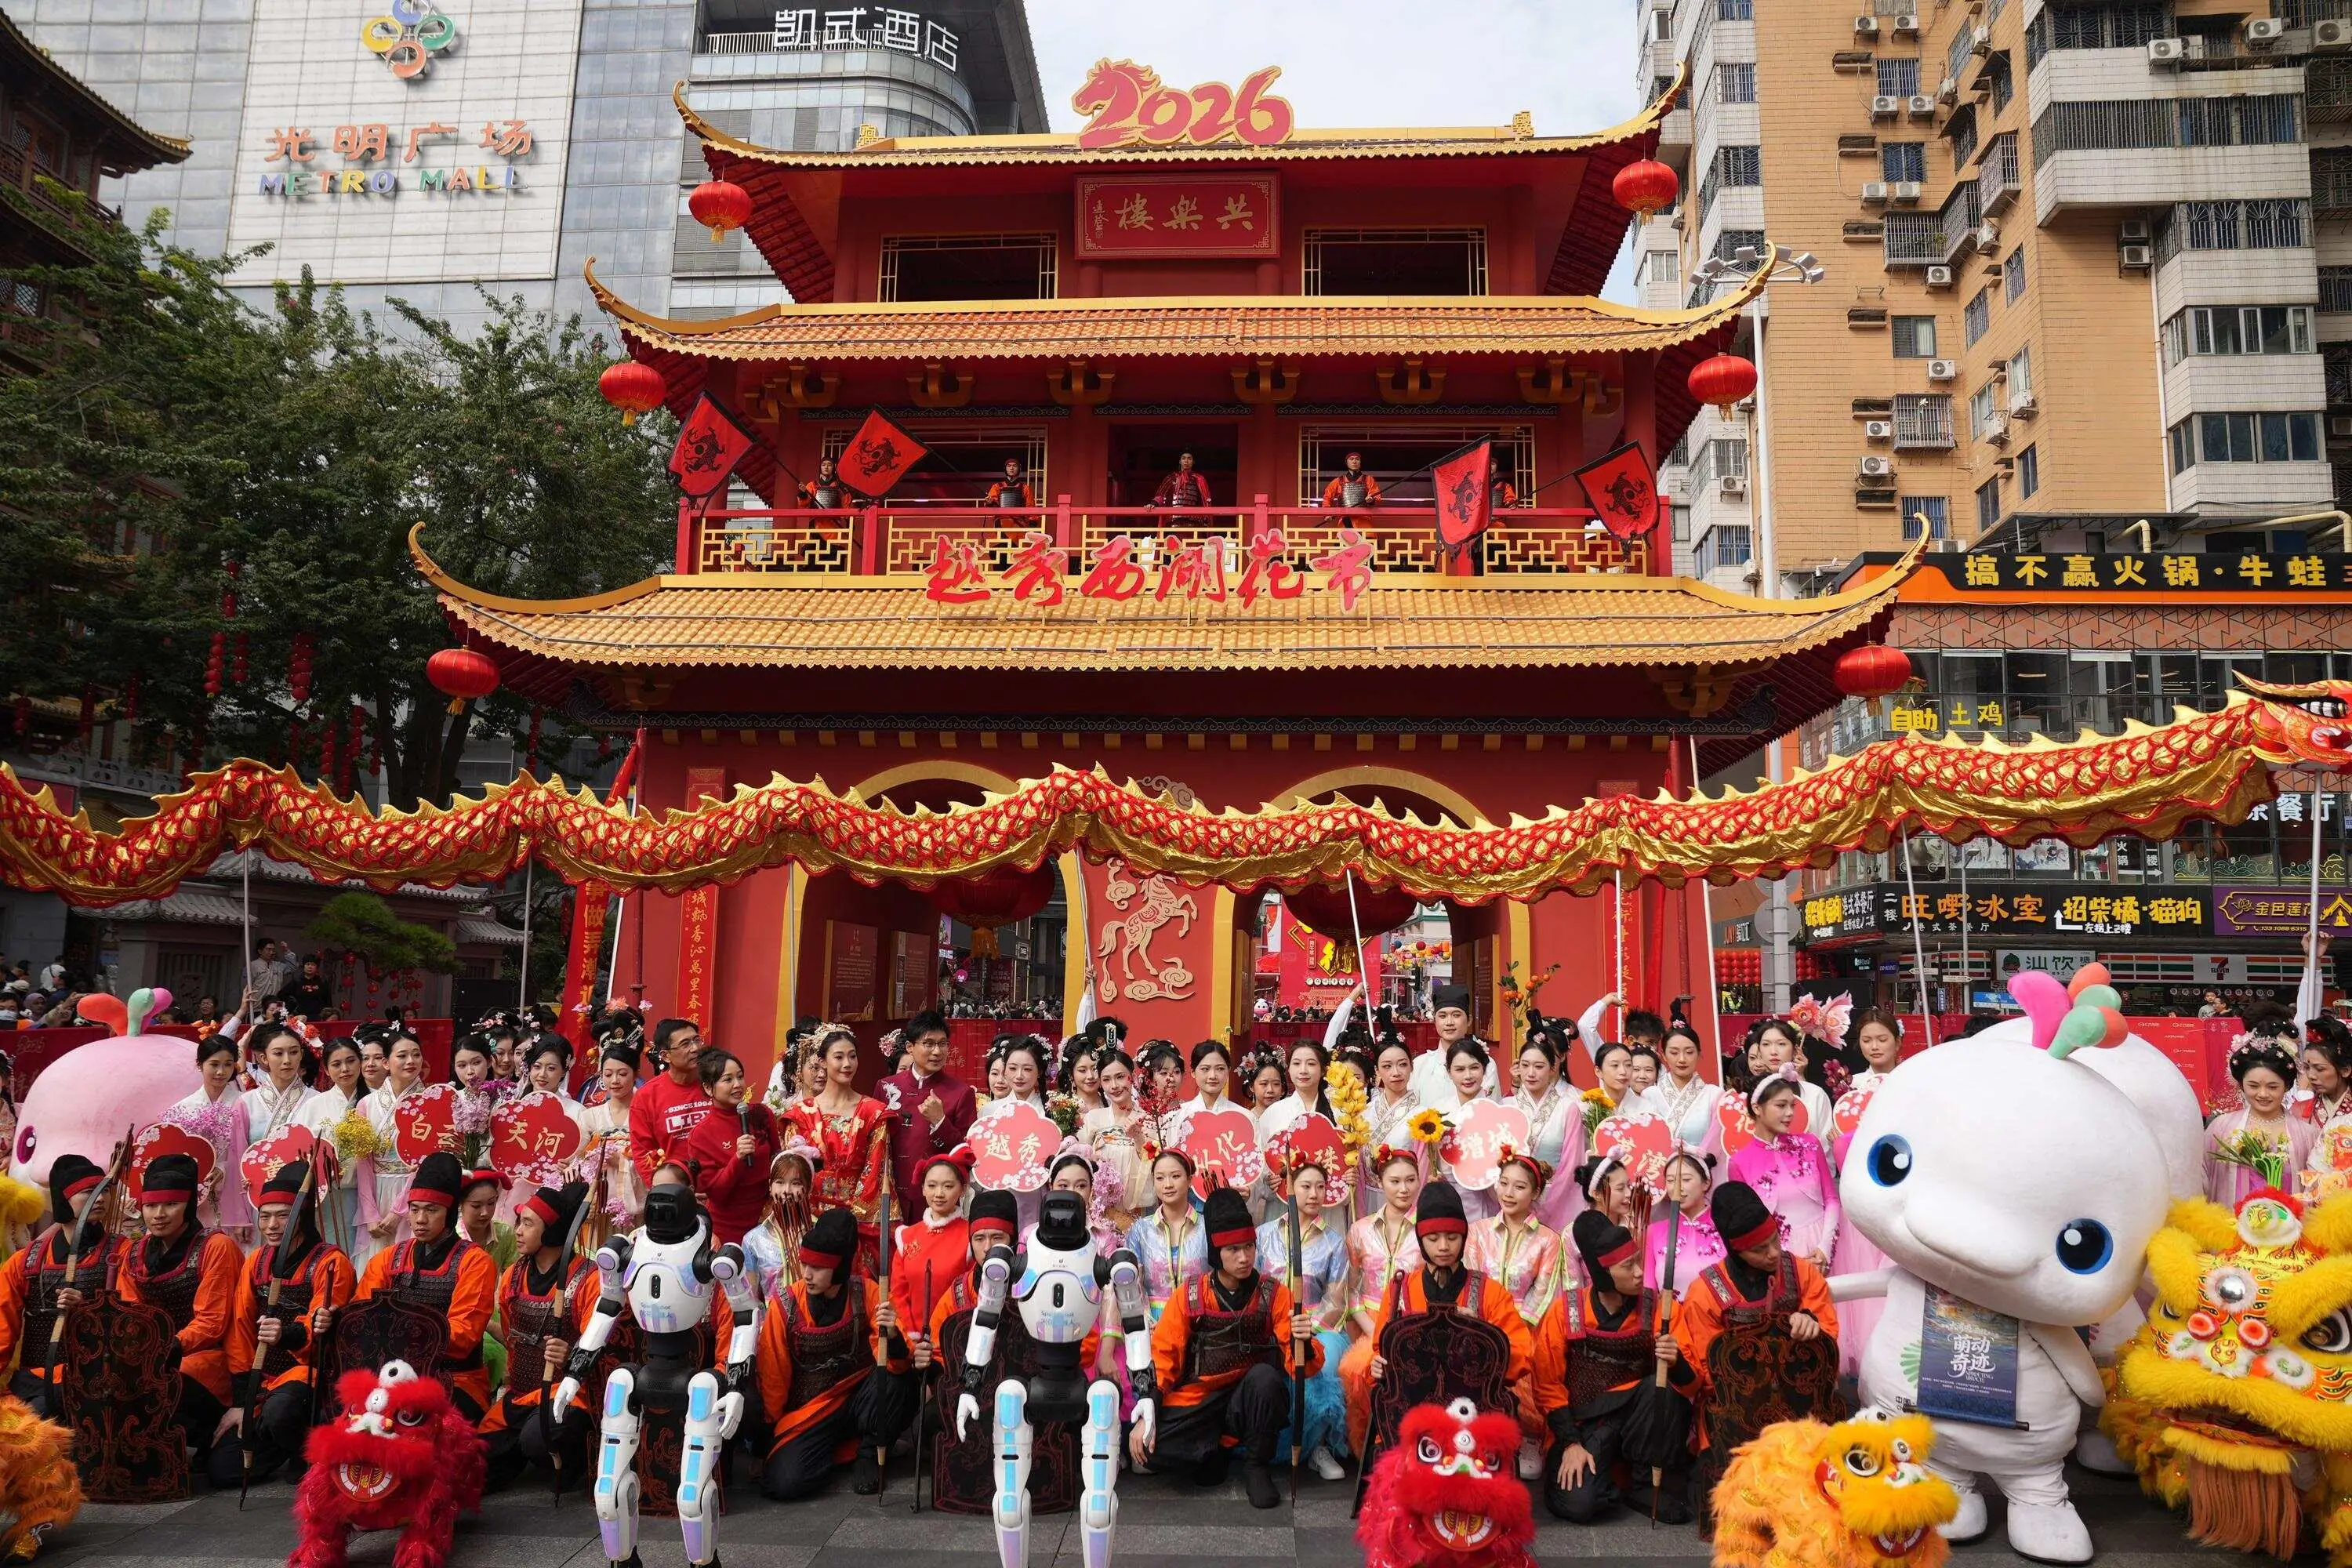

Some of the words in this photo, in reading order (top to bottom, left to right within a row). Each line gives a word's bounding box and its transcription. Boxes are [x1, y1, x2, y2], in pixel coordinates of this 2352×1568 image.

[1073, 58, 1294, 149] 2026
[264, 119, 533, 163] 光明广场
[259, 169, 396, 196] METRO
[419, 165, 528, 192] MALL
[924, 528, 1377, 614] 越秀西湖花市
[1890, 706, 1938, 731] 自助
[1949, 701, 2003, 726] 土鸡
[1884, 892, 1898, 922] 二楼
[2026, 955, 2074, 971] 汕饮
[668, 1103, 694, 1113] SINCE
[503, 1120, 565, 1159] 天河
[982, 1131, 1042, 1163] 越秀
[1192, 1130, 1247, 1178] 从化
[1947, 1333, 1994, 1354] 萌动
[1947, 1352, 1997, 1378] 奇迹
